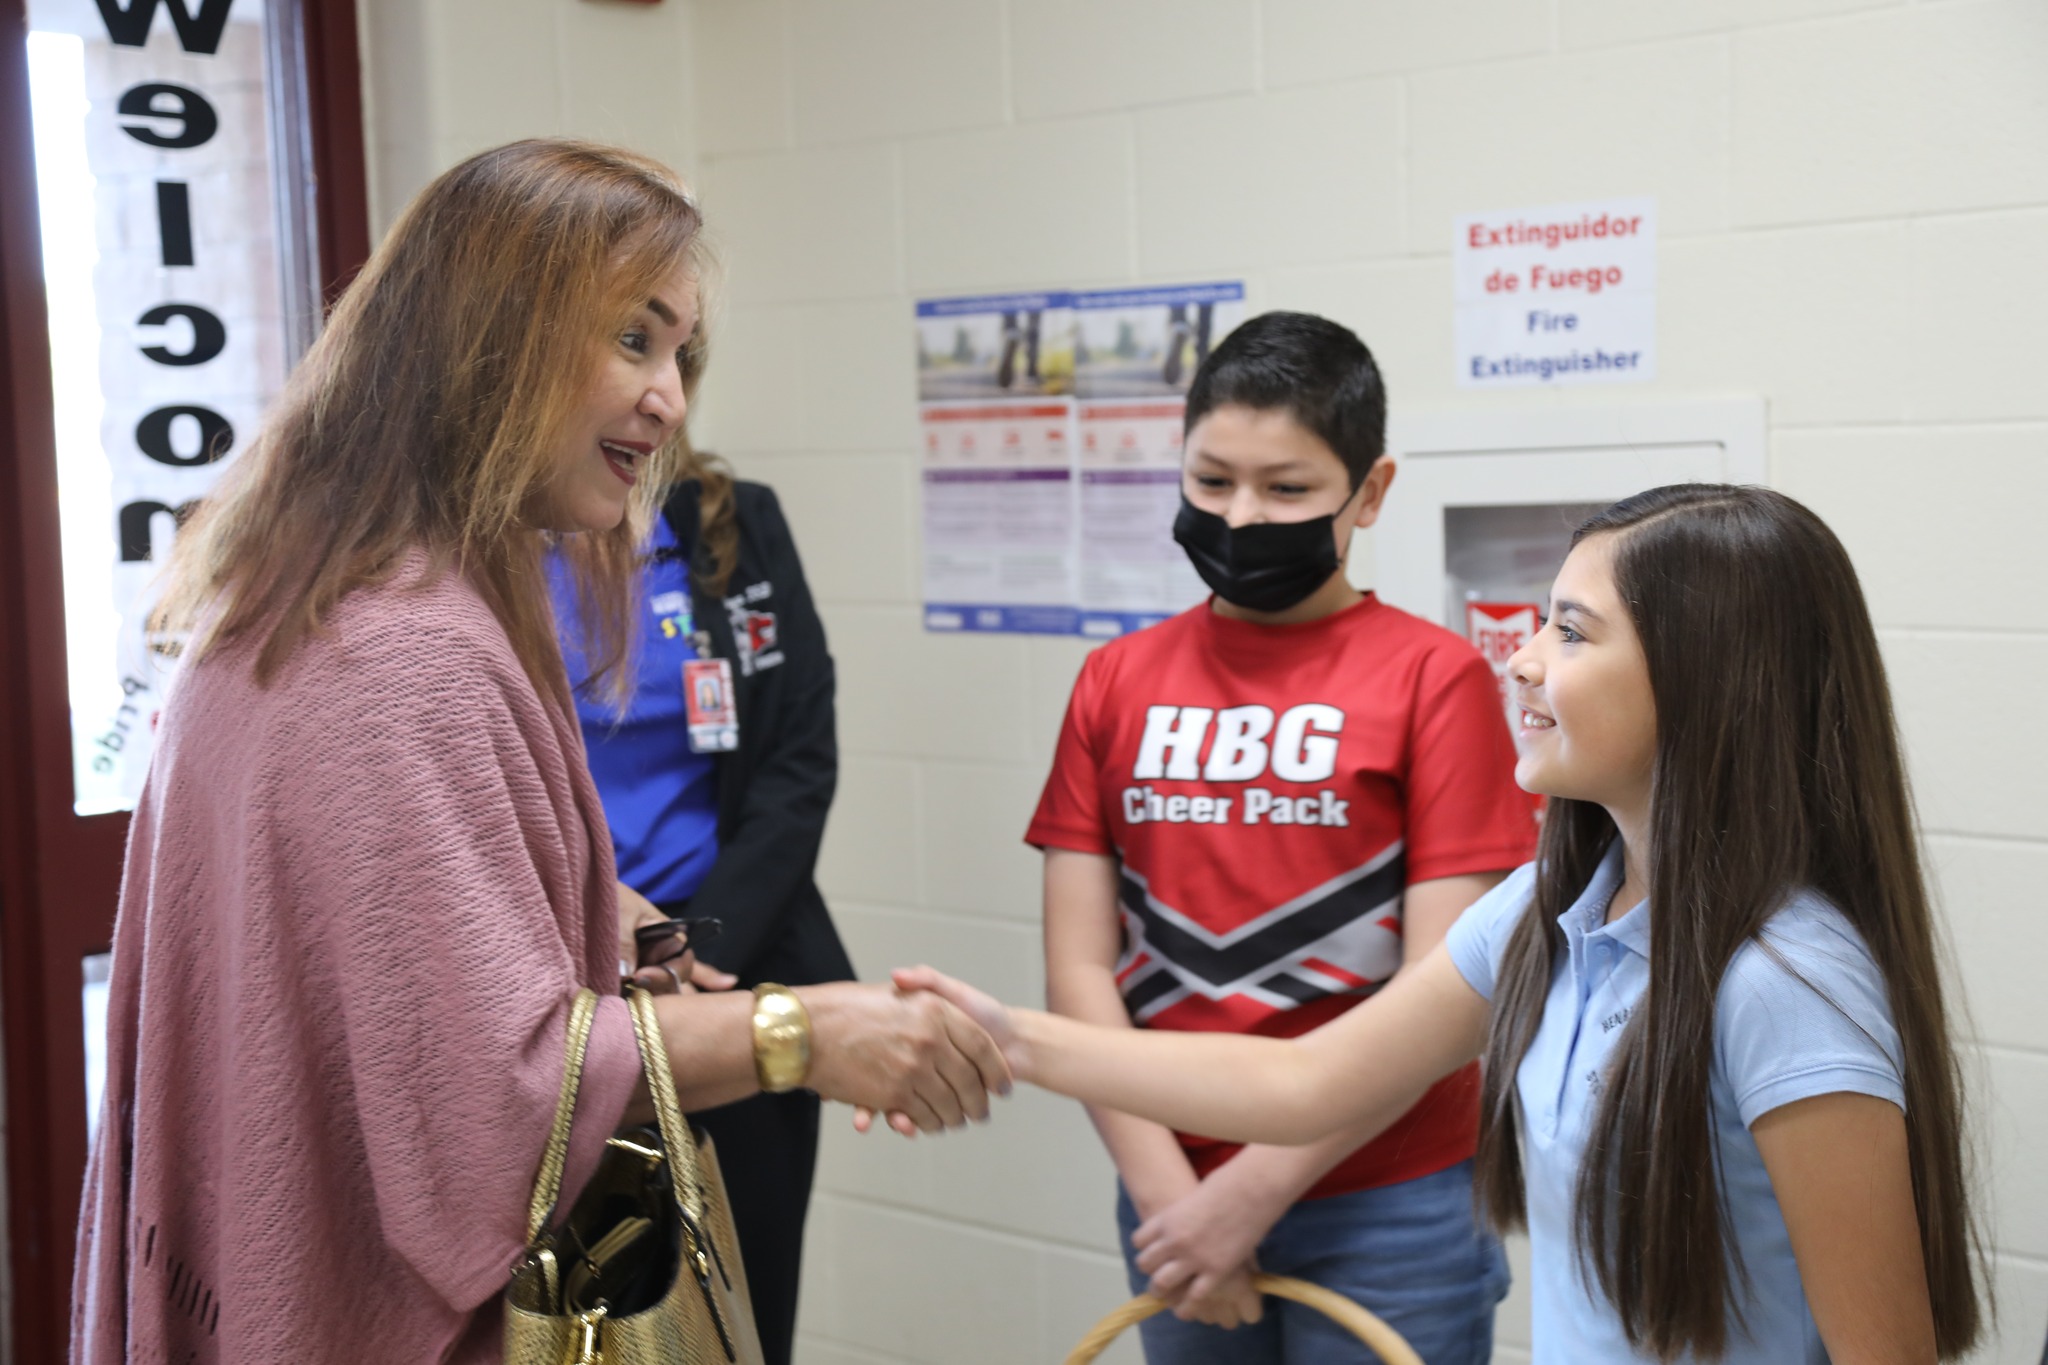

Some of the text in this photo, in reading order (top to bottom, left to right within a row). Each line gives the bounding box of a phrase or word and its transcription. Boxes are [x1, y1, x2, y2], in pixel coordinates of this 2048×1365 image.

[1468, 213, 1642, 248] Extinguidor
[1484, 264, 1623, 294] de Fuego
[1527, 310, 1578, 333] Fire
[1470, 348, 1641, 379] Extinguisher
[1133, 702, 1346, 783] HBG
[1122, 786, 1350, 827] Cheer Pack
